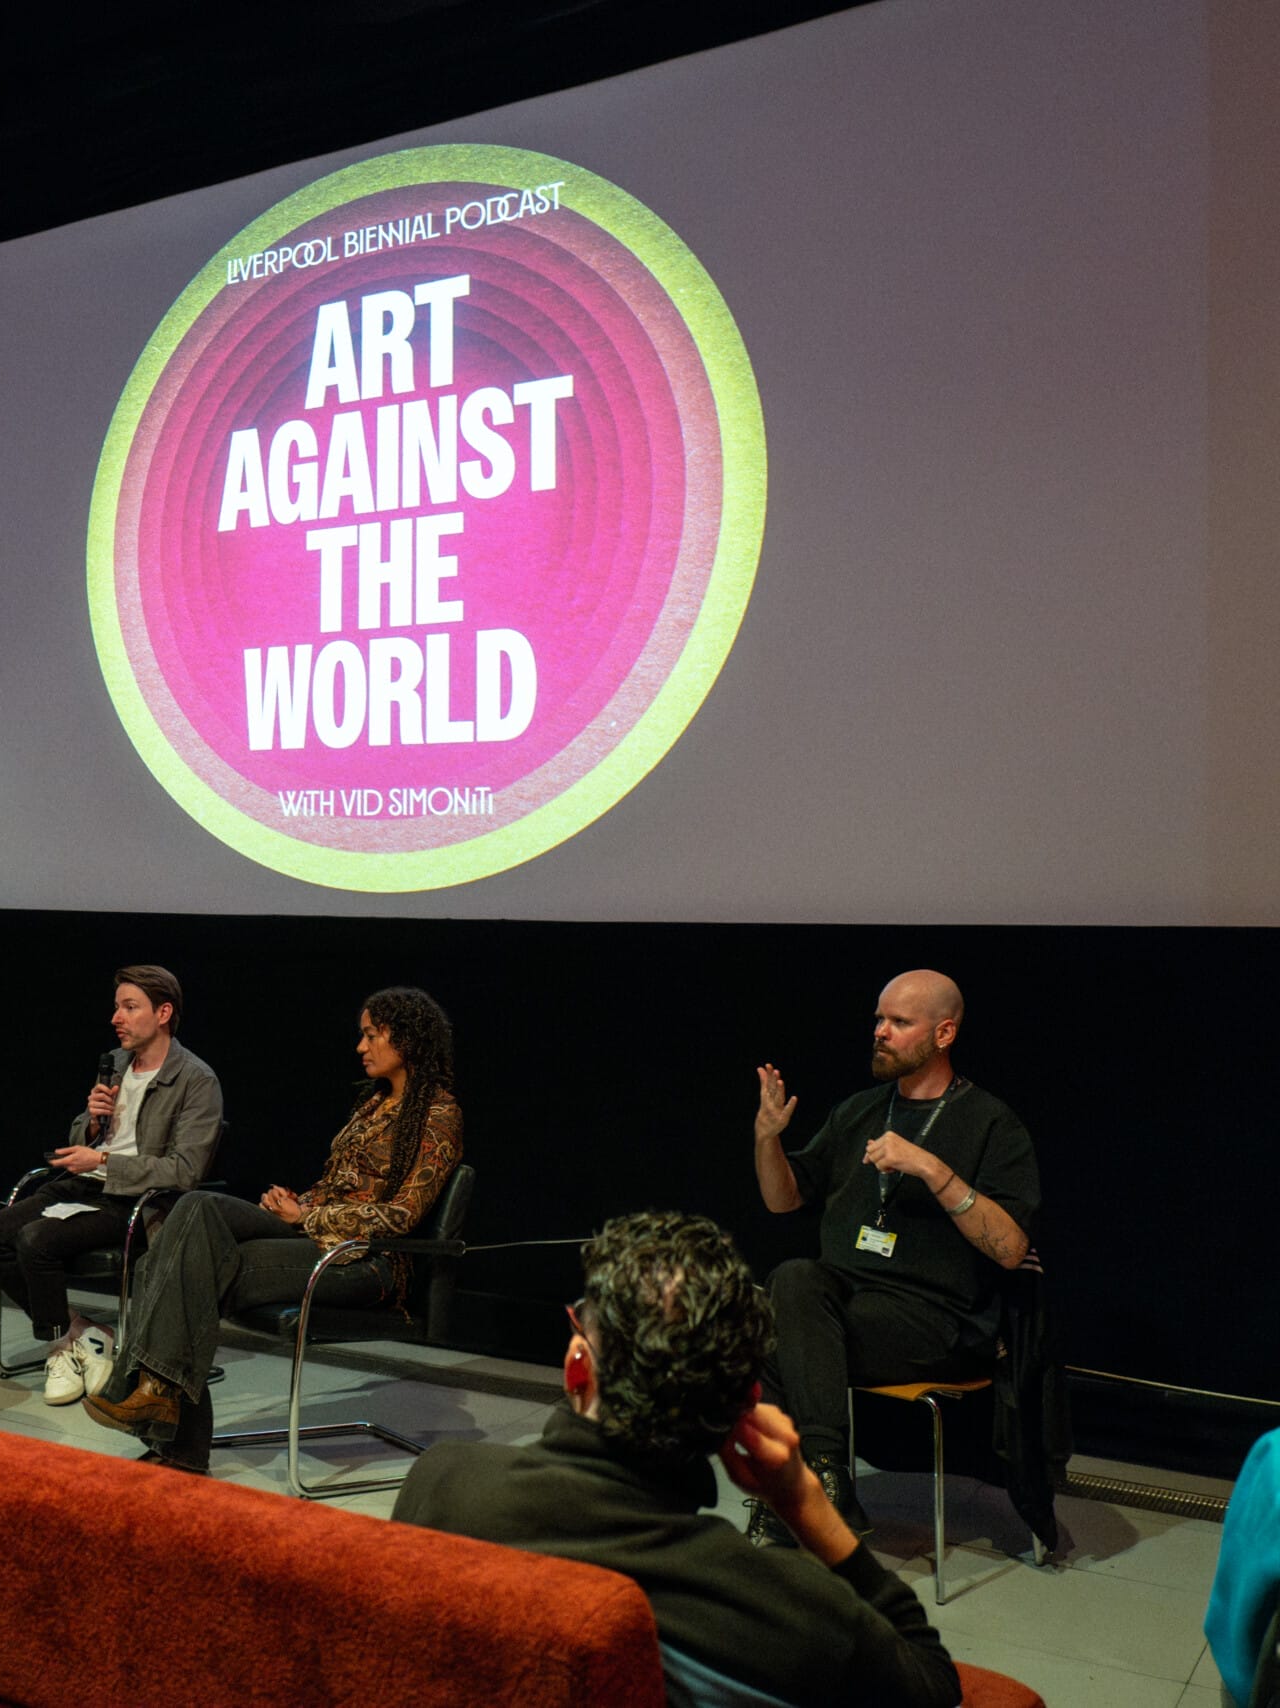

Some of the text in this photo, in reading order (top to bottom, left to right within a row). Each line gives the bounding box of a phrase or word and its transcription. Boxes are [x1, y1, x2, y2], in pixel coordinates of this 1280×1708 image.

[226, 181, 565, 285] LIVERPOOL BIENNIAL PODCAST
[305, 274, 470, 410] ART
[218, 375, 573, 532] AGAINST
[306, 511, 464, 633] THE
[244, 628, 537, 751] WORLD
[340, 789, 383, 816] VID
